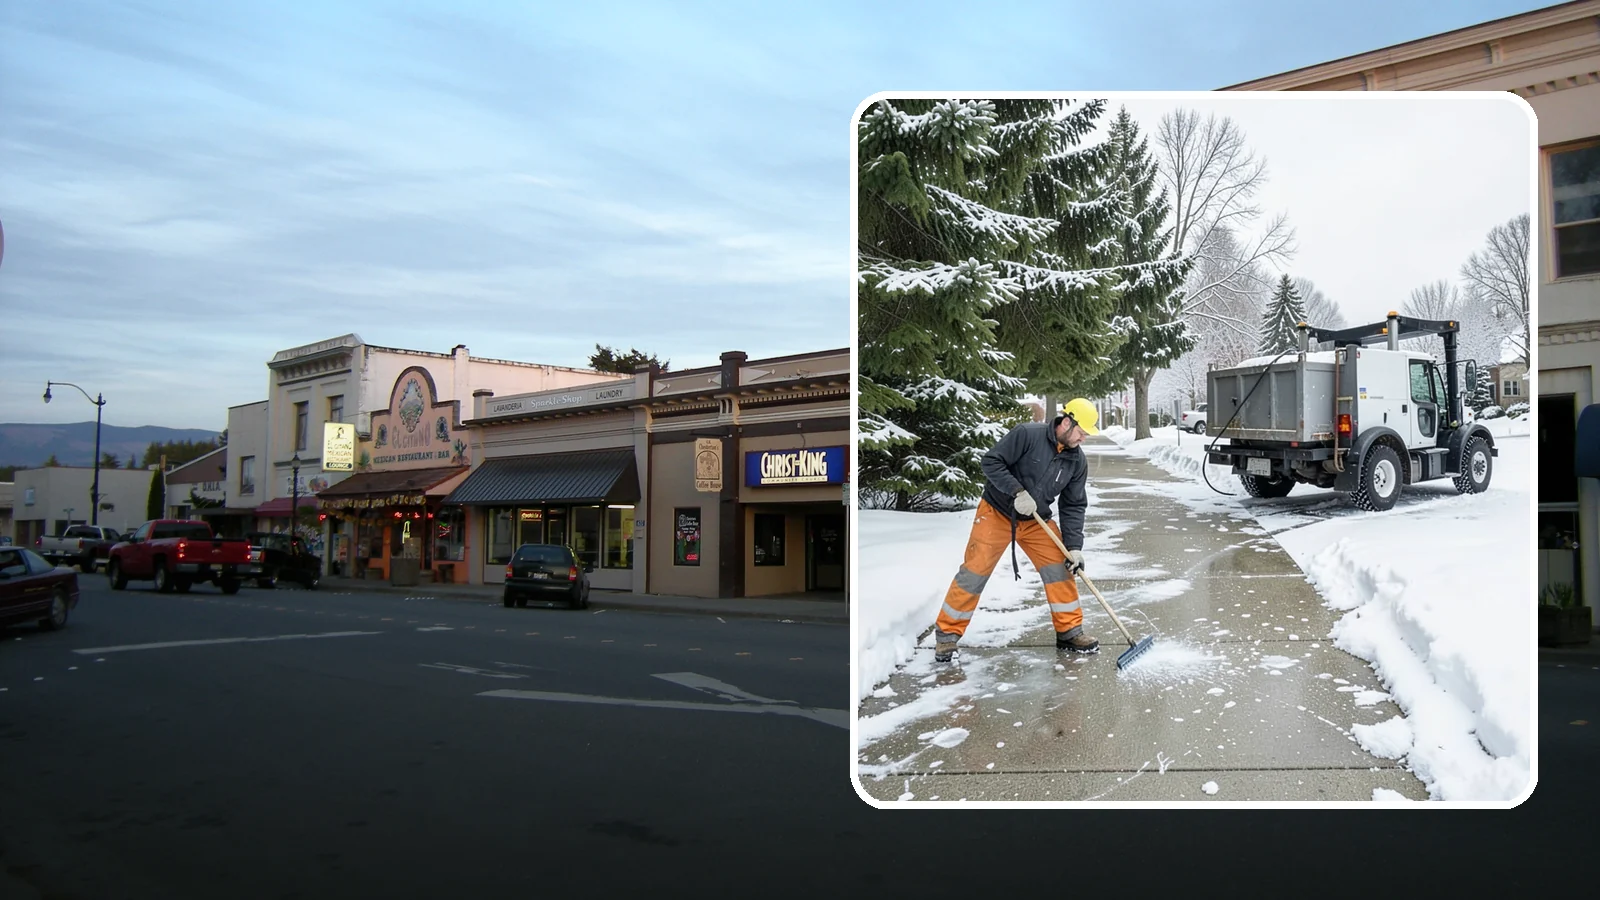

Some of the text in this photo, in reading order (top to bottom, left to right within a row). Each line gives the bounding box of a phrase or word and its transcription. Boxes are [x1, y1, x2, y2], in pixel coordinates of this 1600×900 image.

[494, 389, 623, 412] LAVANDERIA Sparkle Shop LAUNDRY
[374, 455, 396, 464] MEXICAN
[397, 452, 433, 462] RESTAURANT
[438, 450, 450, 458] BAR
[761, 450, 827, 478] CHRIST KING
